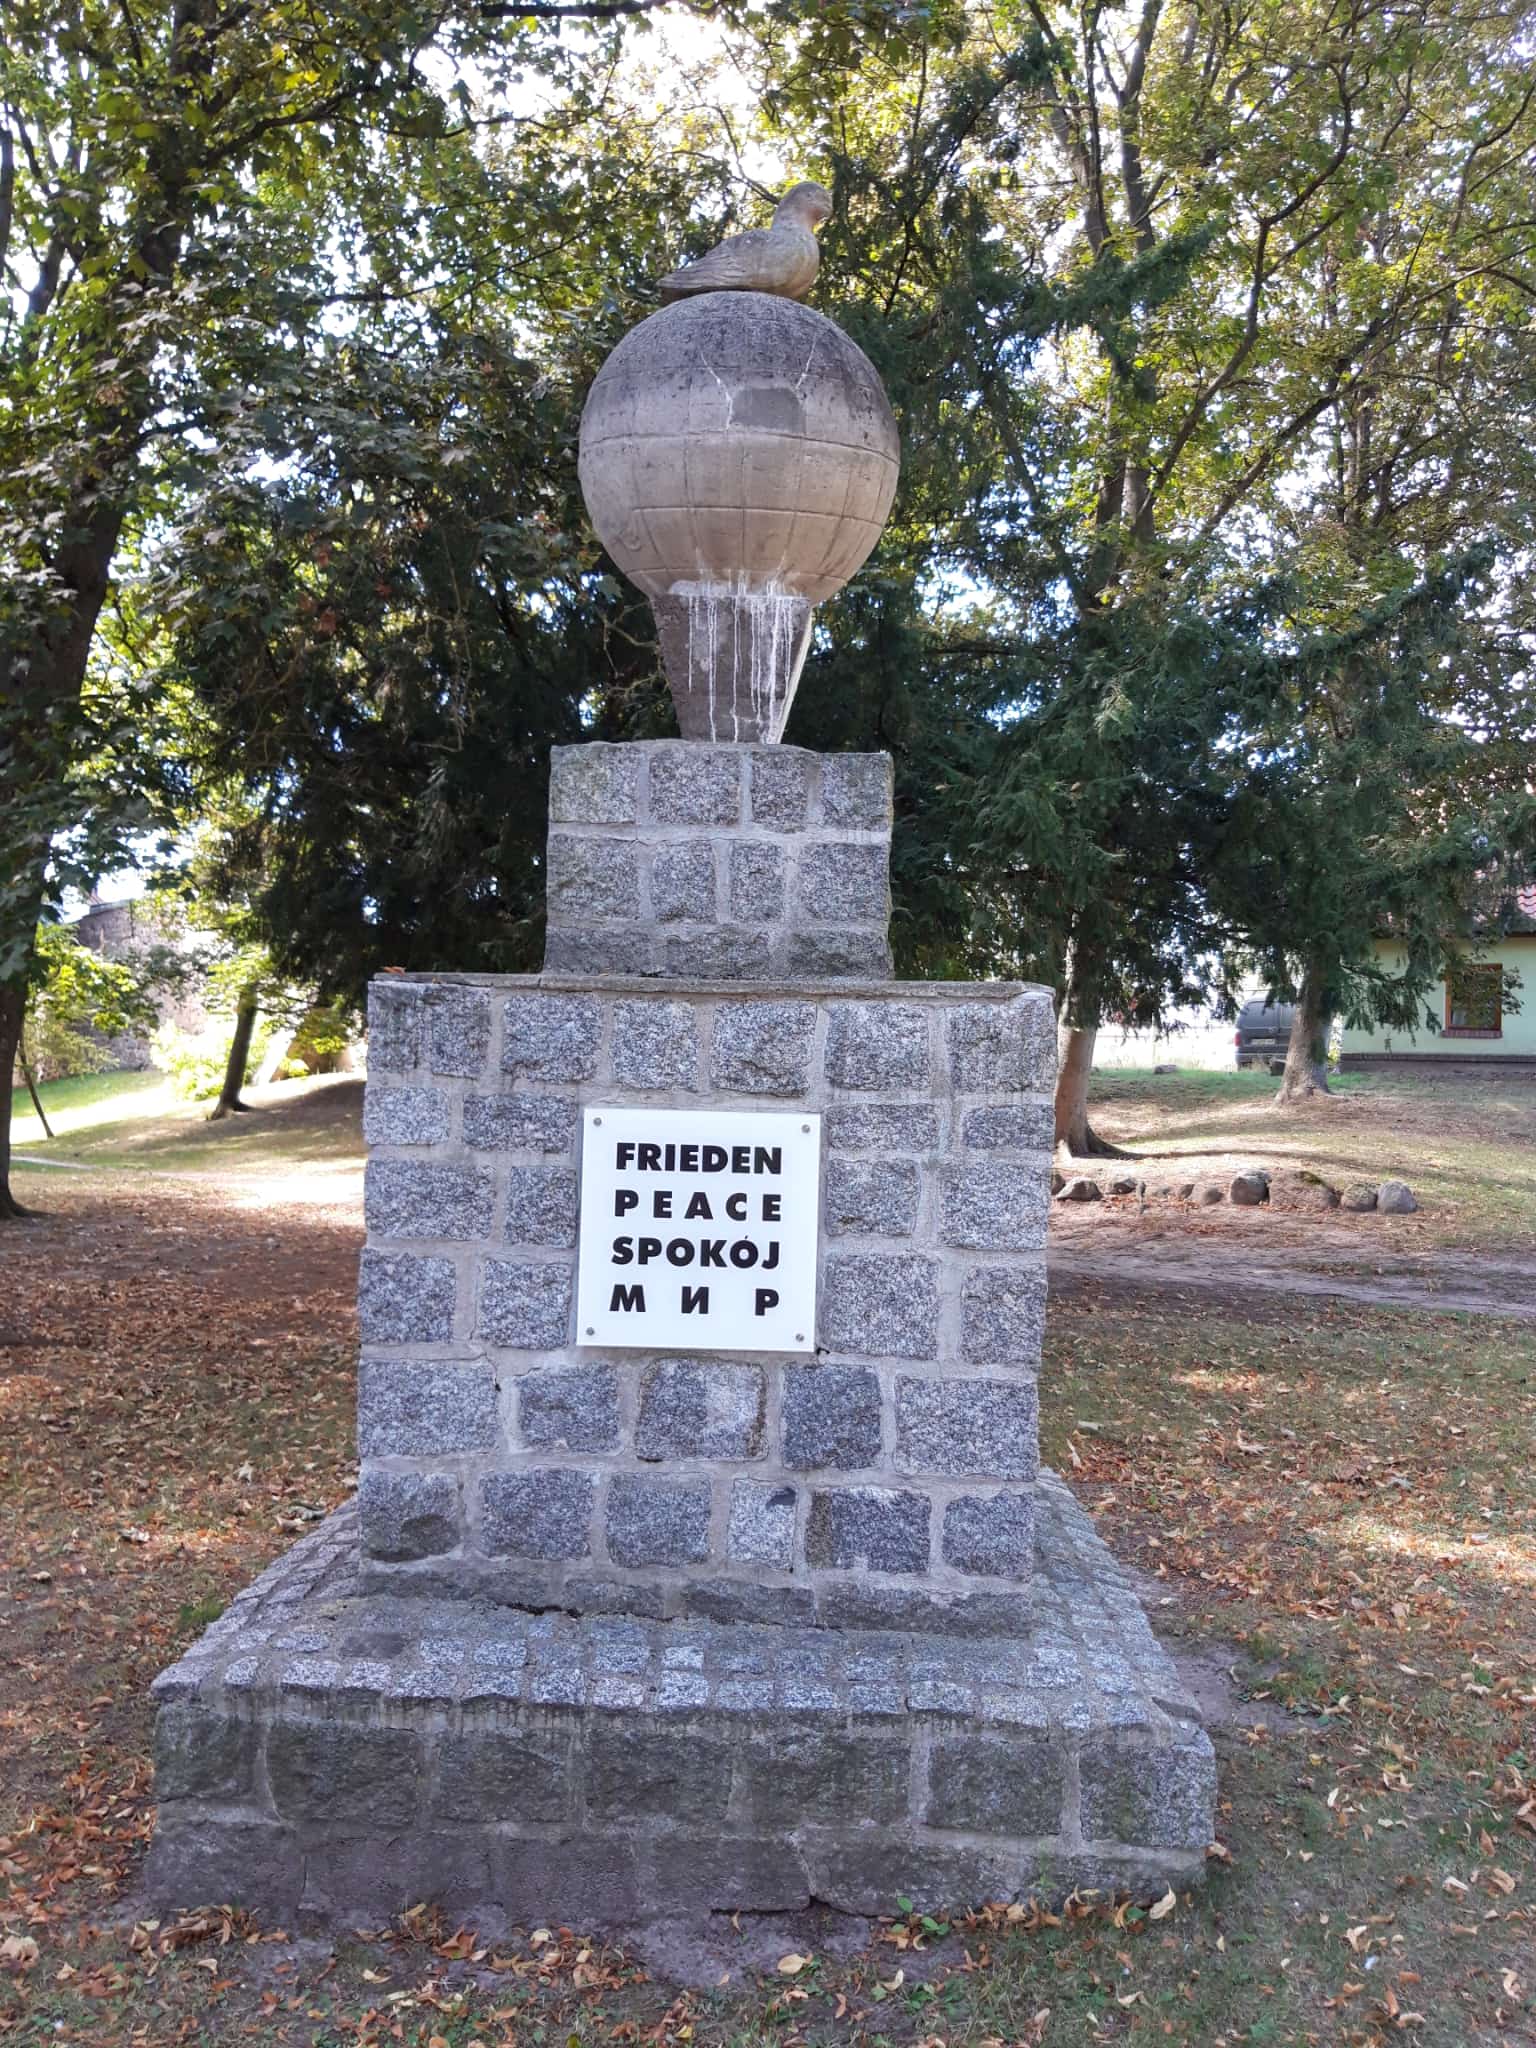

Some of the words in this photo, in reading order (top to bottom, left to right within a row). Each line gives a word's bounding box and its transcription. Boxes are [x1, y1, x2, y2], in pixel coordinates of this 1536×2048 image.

[616, 1142, 782, 1174] FRIEDEN
[614, 1189, 781, 1222] PEACE
[611, 1235, 780, 1269] SPOKÓJ
[609, 1284, 779, 1316] МИР
